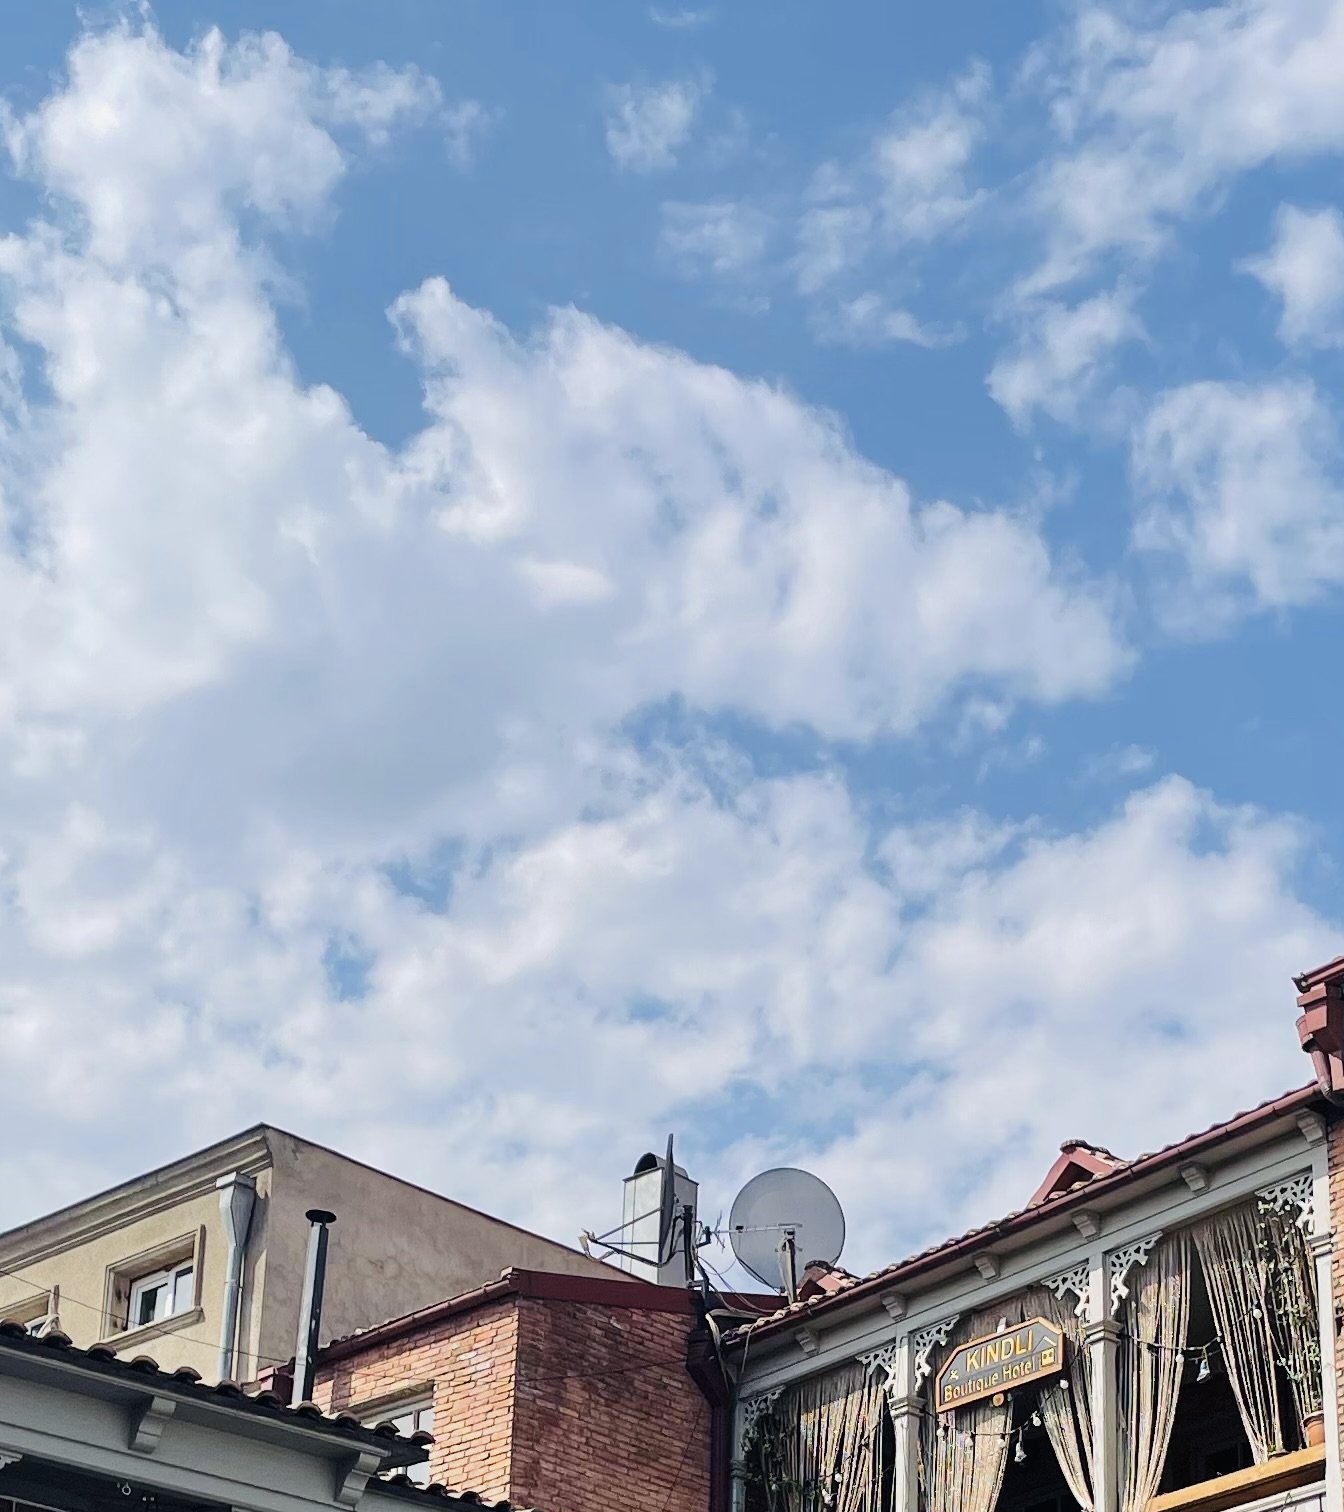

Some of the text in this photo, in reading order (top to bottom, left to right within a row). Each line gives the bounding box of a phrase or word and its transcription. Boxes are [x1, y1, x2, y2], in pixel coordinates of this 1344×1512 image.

[966, 1330, 1035, 1373] KINDLI
[944, 1356, 1038, 1404] Boutique Hotel
